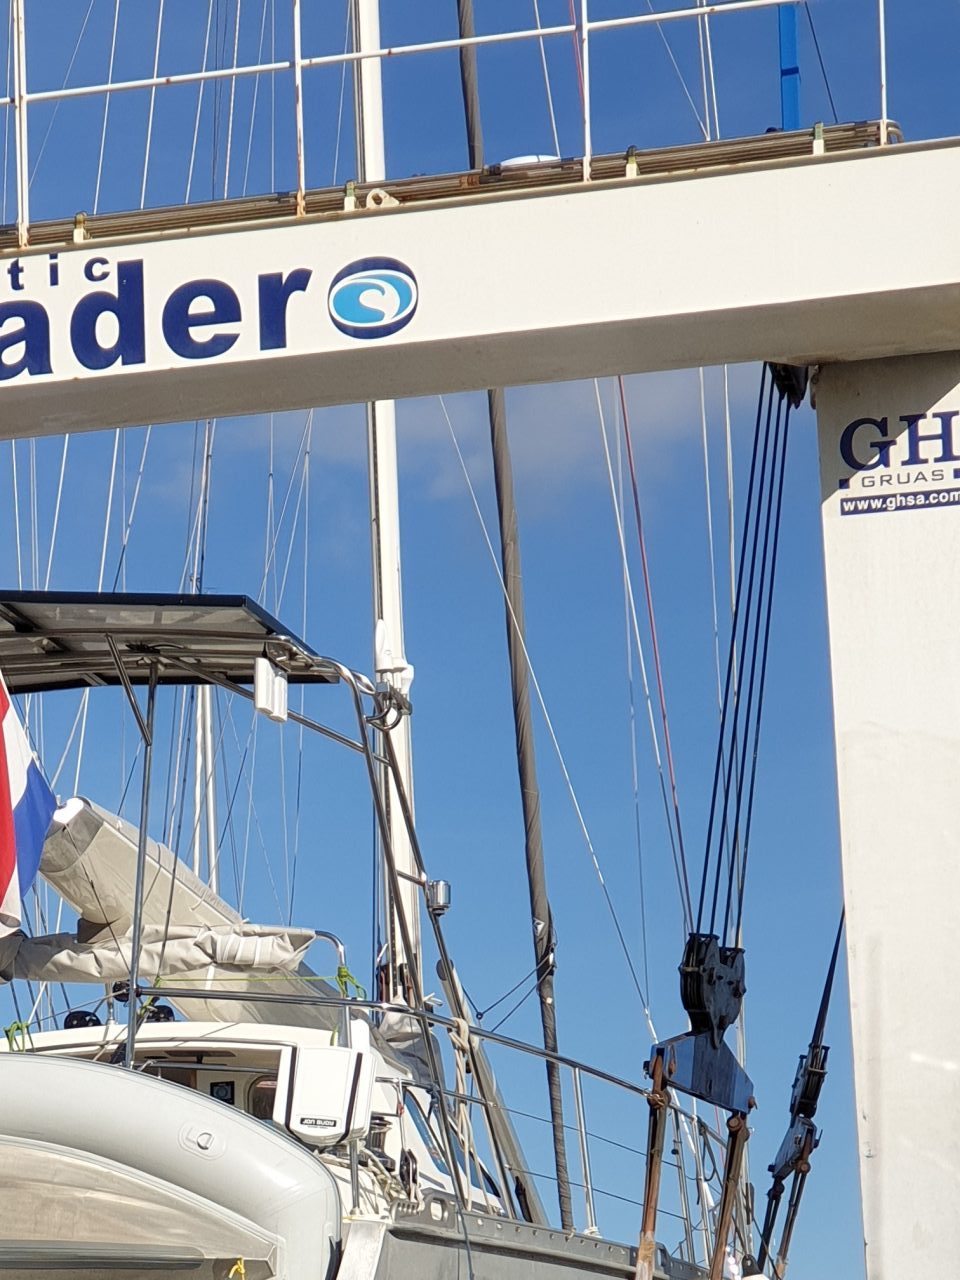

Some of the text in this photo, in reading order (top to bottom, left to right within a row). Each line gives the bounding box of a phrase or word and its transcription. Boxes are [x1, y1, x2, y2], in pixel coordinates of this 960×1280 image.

[840, 410, 960, 471] GH
[861, 469, 945, 488] GRUAS
[842, 491, 960, 512] www.ghsa.com
